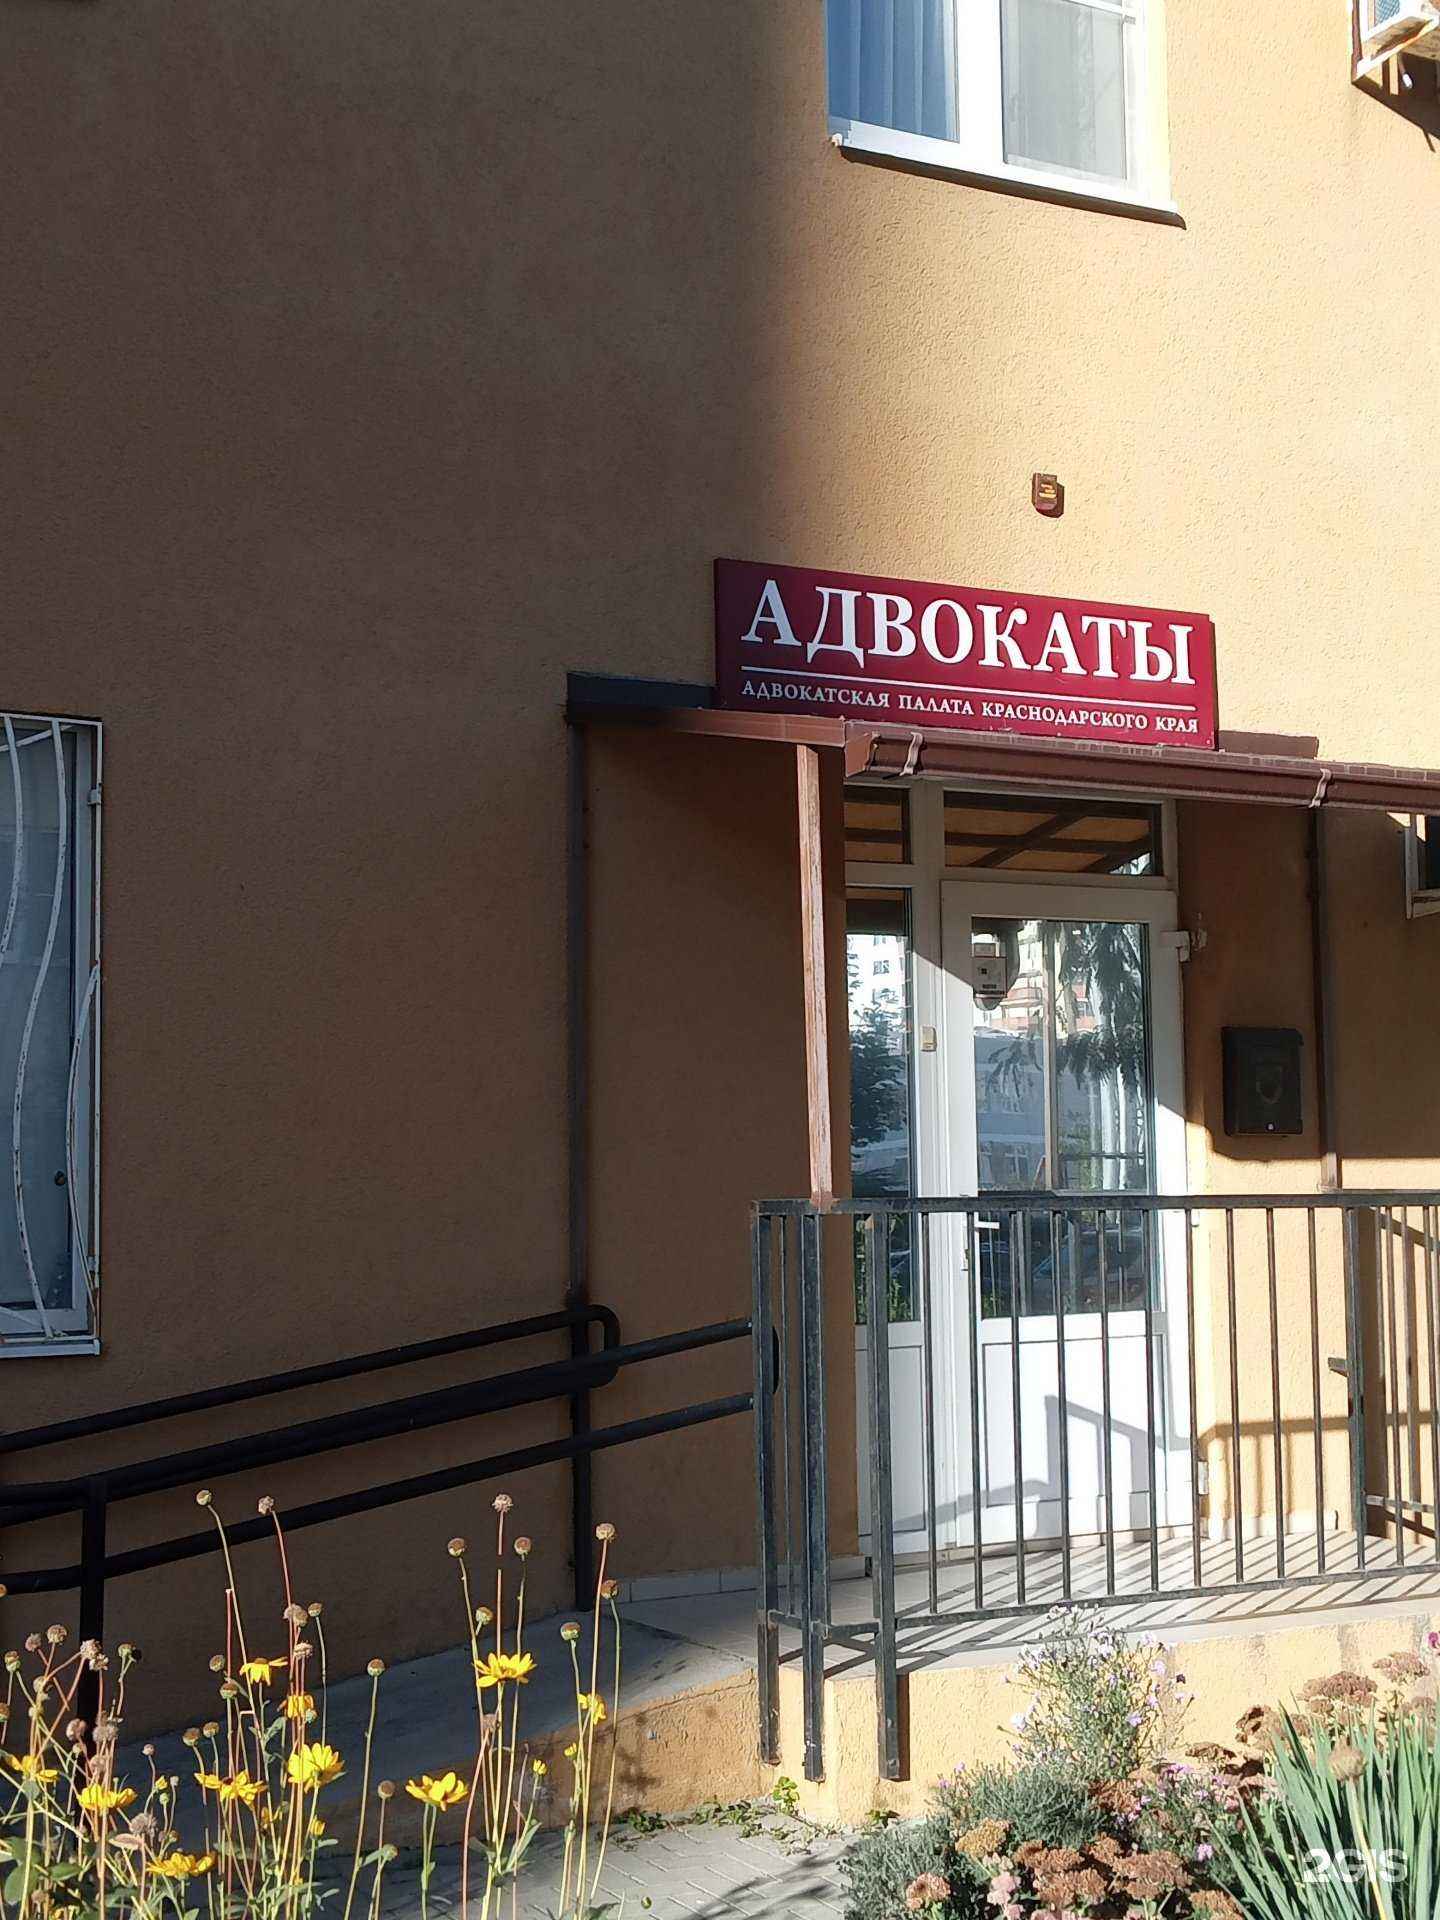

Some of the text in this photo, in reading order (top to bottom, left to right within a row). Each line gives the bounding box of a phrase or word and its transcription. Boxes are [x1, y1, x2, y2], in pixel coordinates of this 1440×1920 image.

[741, 579, 1196, 685] АДВОКАТЫ
[742, 680, 1198, 733] АДВОКАТСКАЯ ПАЛАТА КРАСНОДАРСКОГО КРАЯ
